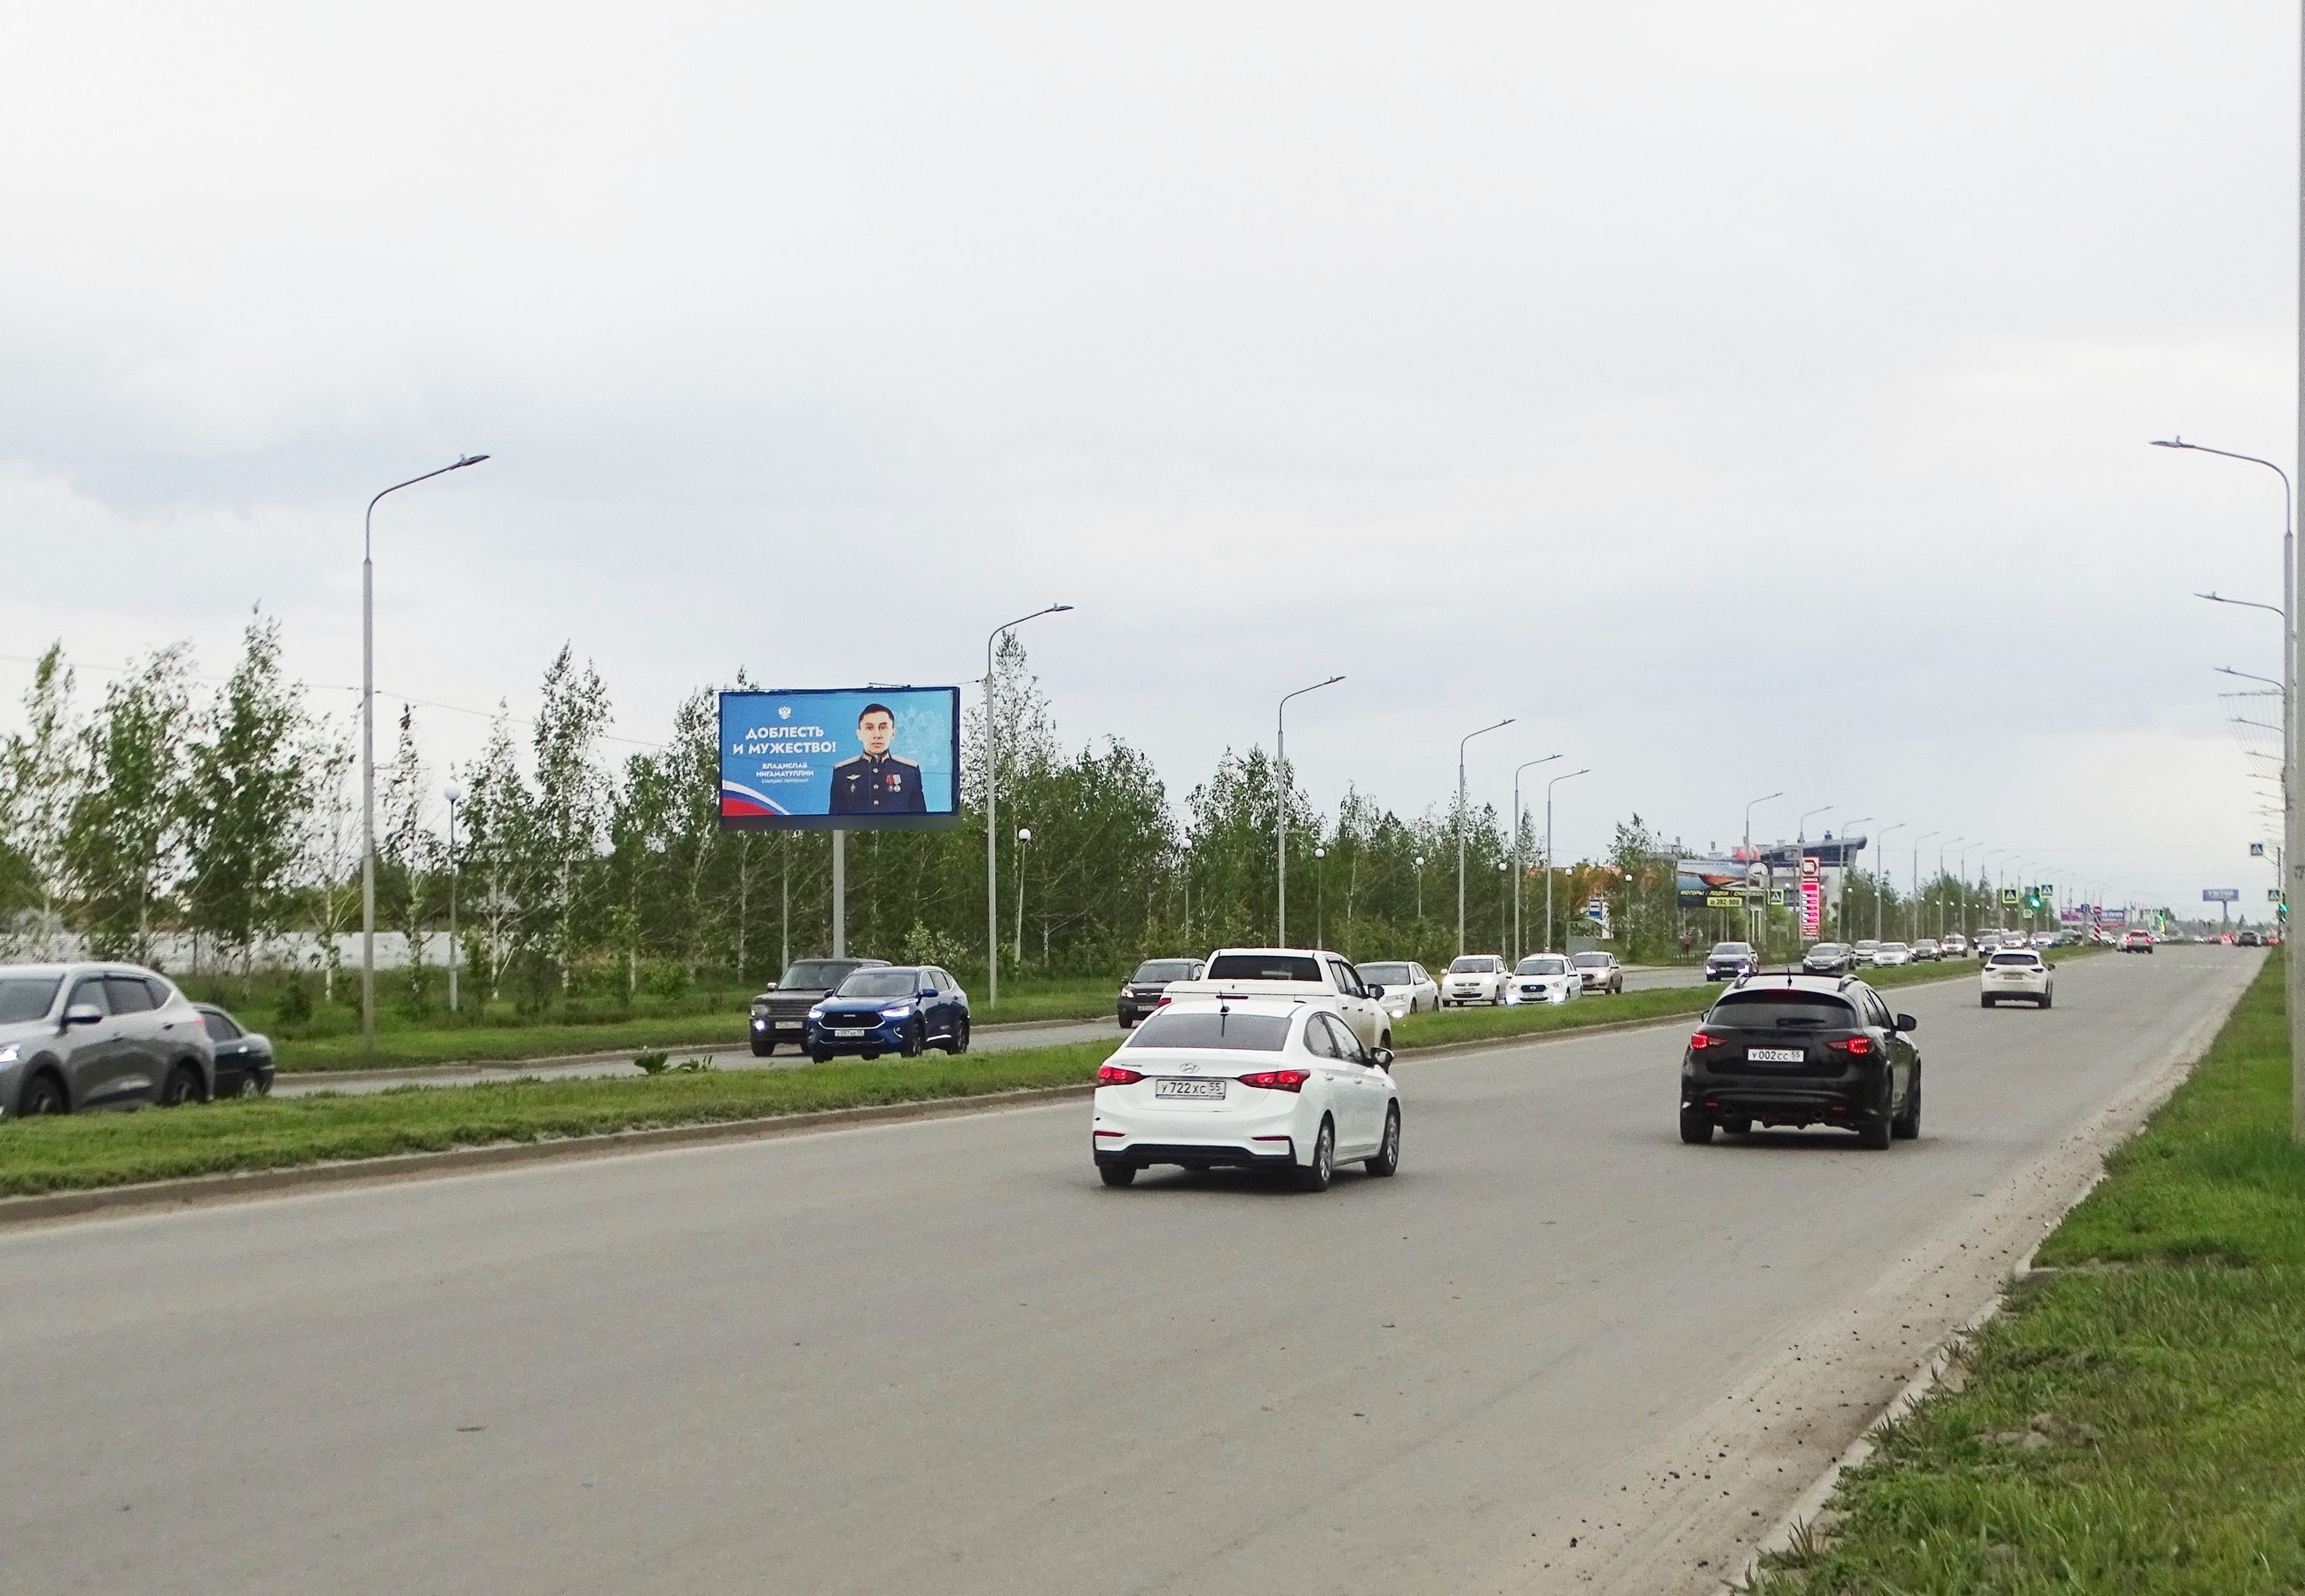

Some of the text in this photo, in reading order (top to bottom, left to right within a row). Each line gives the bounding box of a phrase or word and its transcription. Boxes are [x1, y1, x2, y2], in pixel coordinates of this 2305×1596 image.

[746, 726, 824, 740] ДОБЛЕСТЬ
[733, 741, 836, 755] И МУЖЕСТВО!
